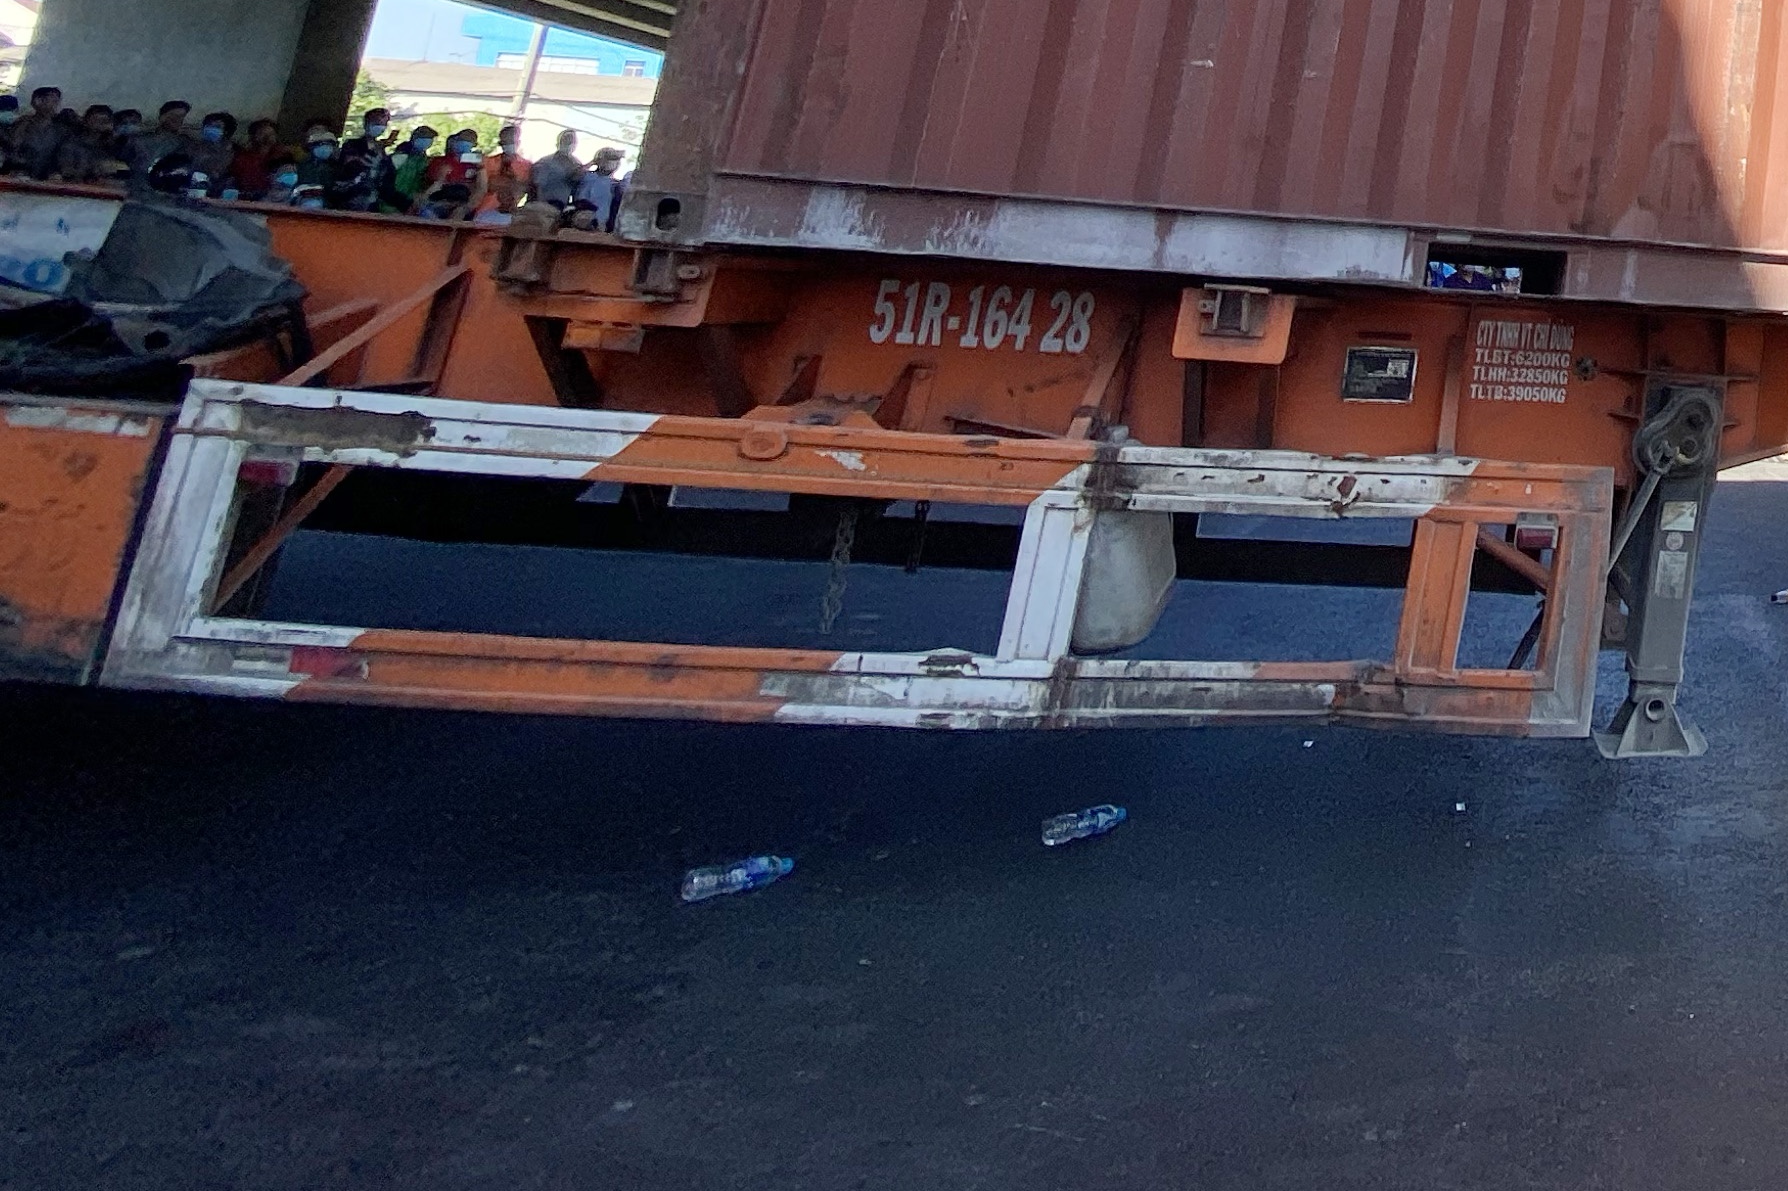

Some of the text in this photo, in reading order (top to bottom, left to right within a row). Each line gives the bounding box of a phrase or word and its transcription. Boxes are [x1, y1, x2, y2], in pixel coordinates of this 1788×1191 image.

[869, 279, 1096, 353] 51R-164 28
[1476, 320, 1496, 347] CTY
[1496, 321, 1521, 348] TNHH
[1521, 322, 1533, 349] VT
[1472, 366, 1569, 385] TLHH:32850KG
[1470, 384, 1567, 403] TLTB:39050KG
